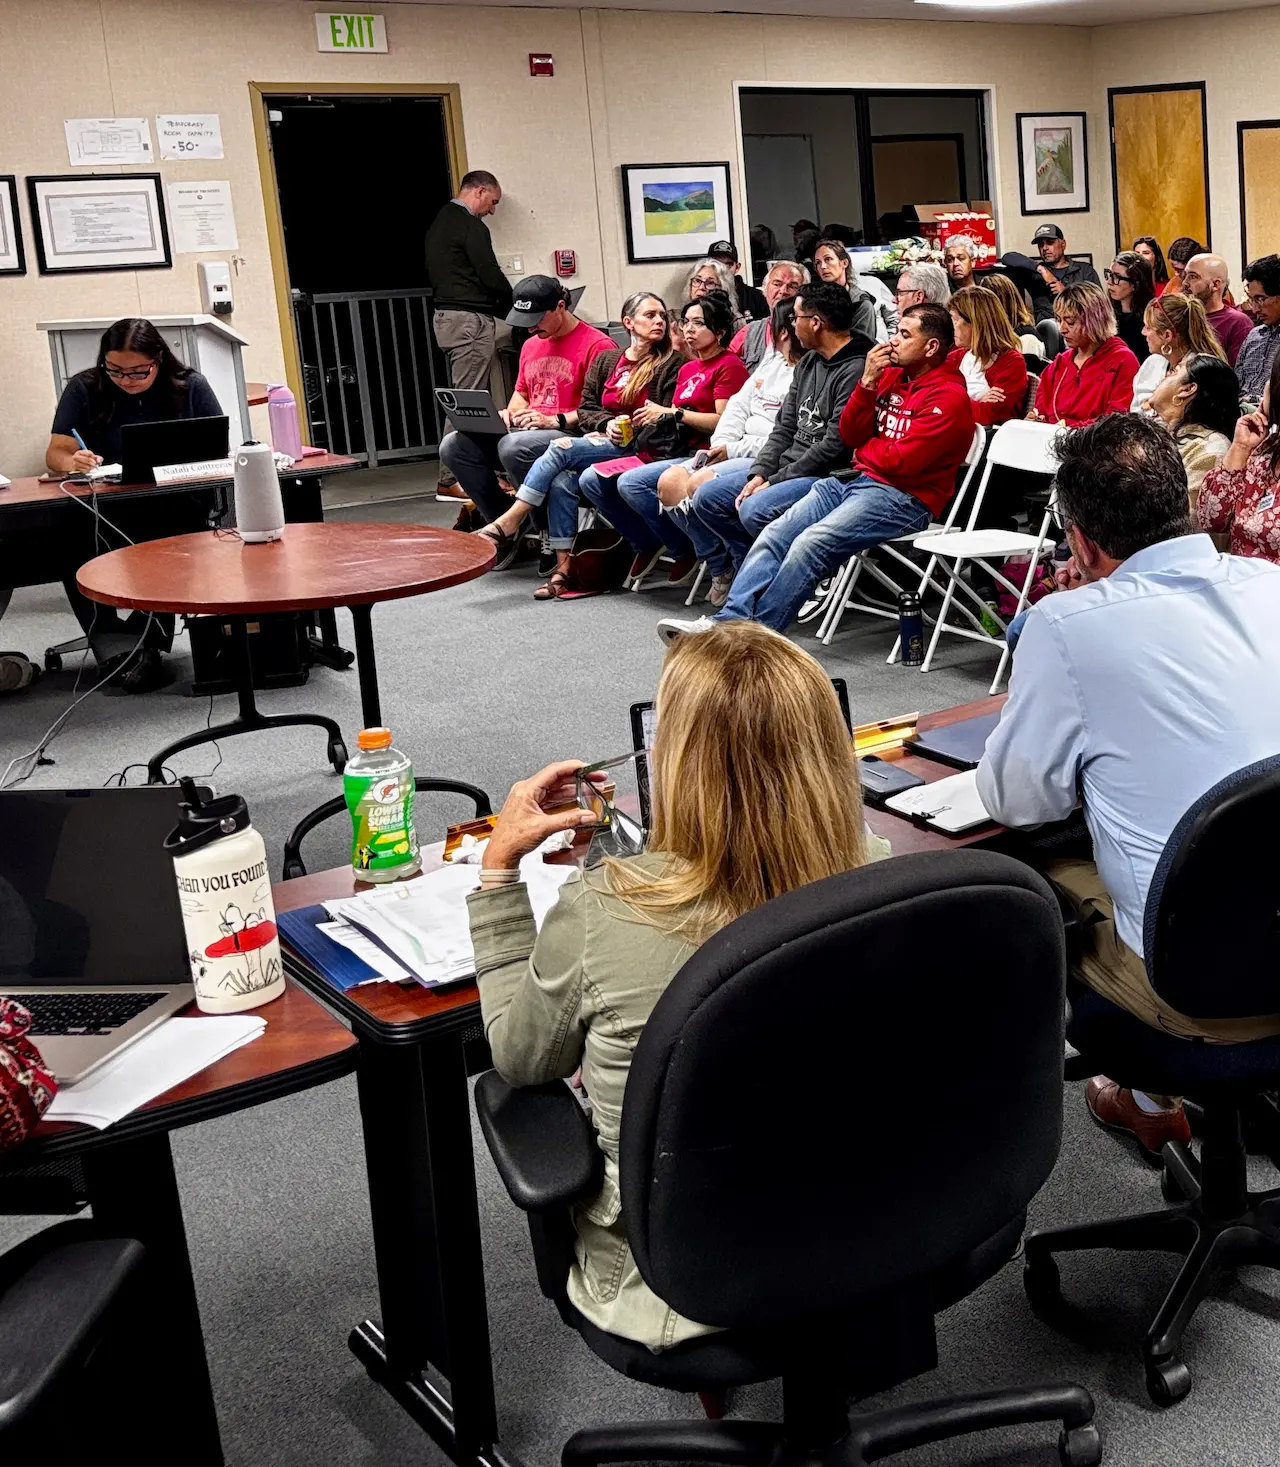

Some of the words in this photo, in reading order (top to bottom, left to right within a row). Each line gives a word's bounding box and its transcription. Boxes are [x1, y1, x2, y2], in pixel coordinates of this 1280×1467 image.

[330, 15, 374, 48] EXIT
[162, 467, 189, 475] Natali
[190, 462, 233, 472] Contreras
[369, 803, 405, 816] LOWER
[368, 812, 405, 827] SUGAR
[201, 874, 231, 893] YOU
